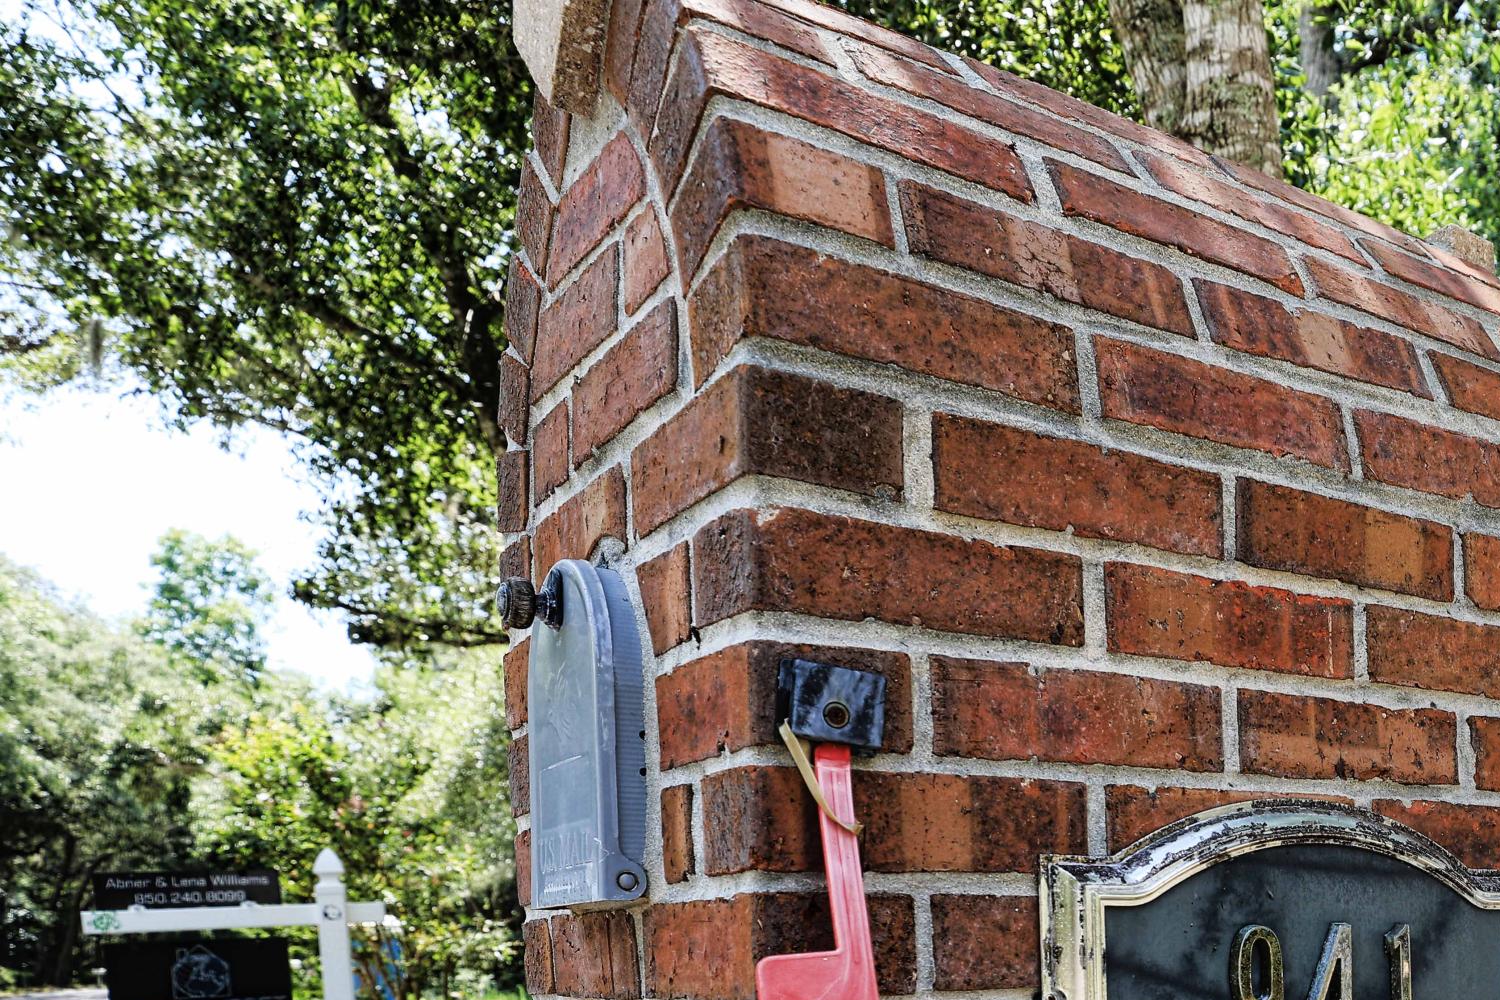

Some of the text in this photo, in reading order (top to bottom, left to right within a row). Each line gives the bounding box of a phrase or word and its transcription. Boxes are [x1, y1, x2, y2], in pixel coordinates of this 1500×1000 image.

[105, 877, 150, 889] Abner
[155, 876, 167, 887] &
[209, 874, 270, 886] Williams
[134, 890, 247, 904] 850.240.8099
